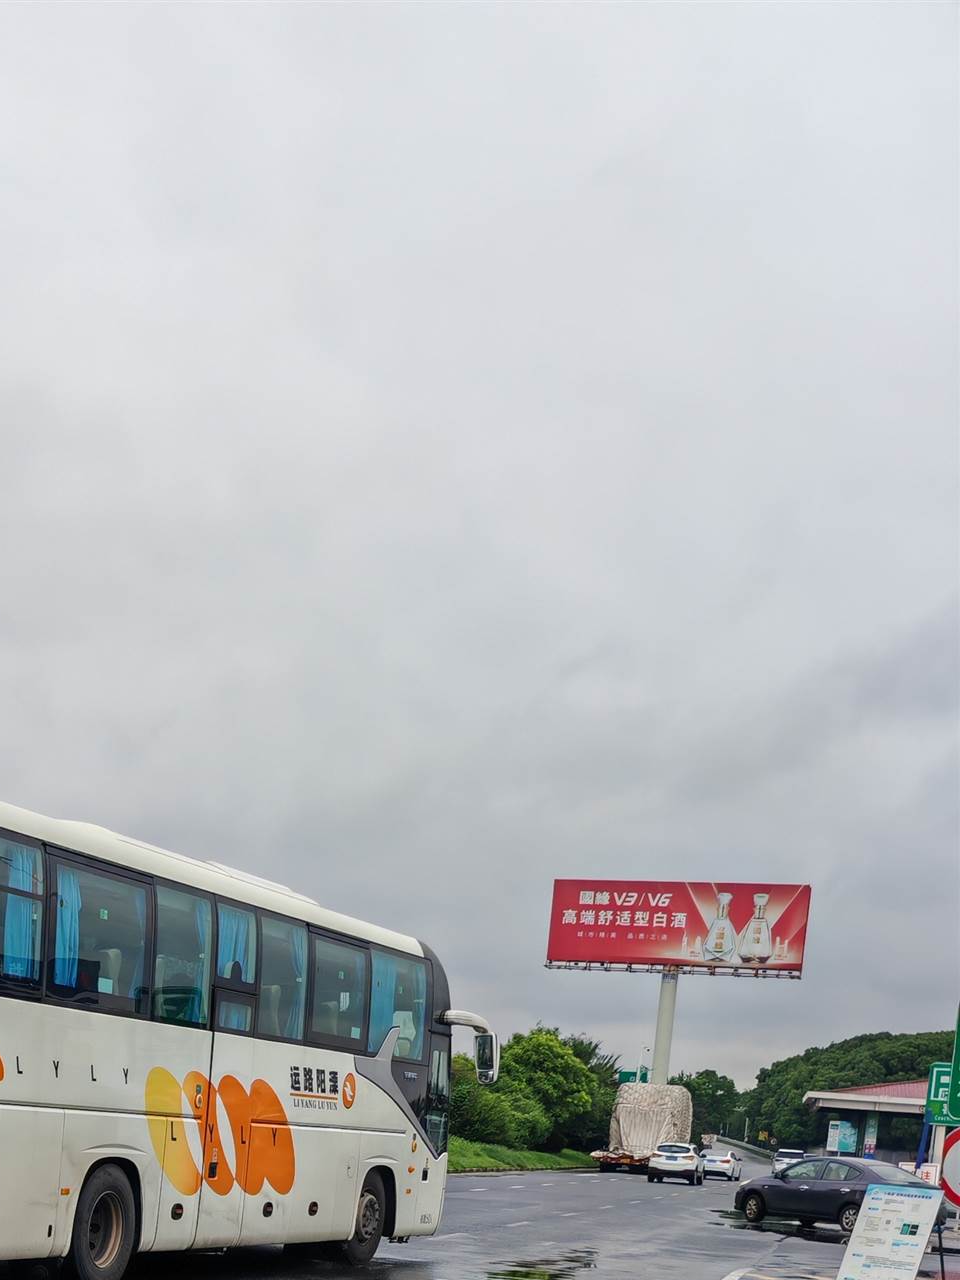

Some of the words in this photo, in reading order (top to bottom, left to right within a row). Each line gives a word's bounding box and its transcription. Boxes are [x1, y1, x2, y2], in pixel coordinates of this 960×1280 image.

[562, 909, 687, 928] 高端舒适型白酒
